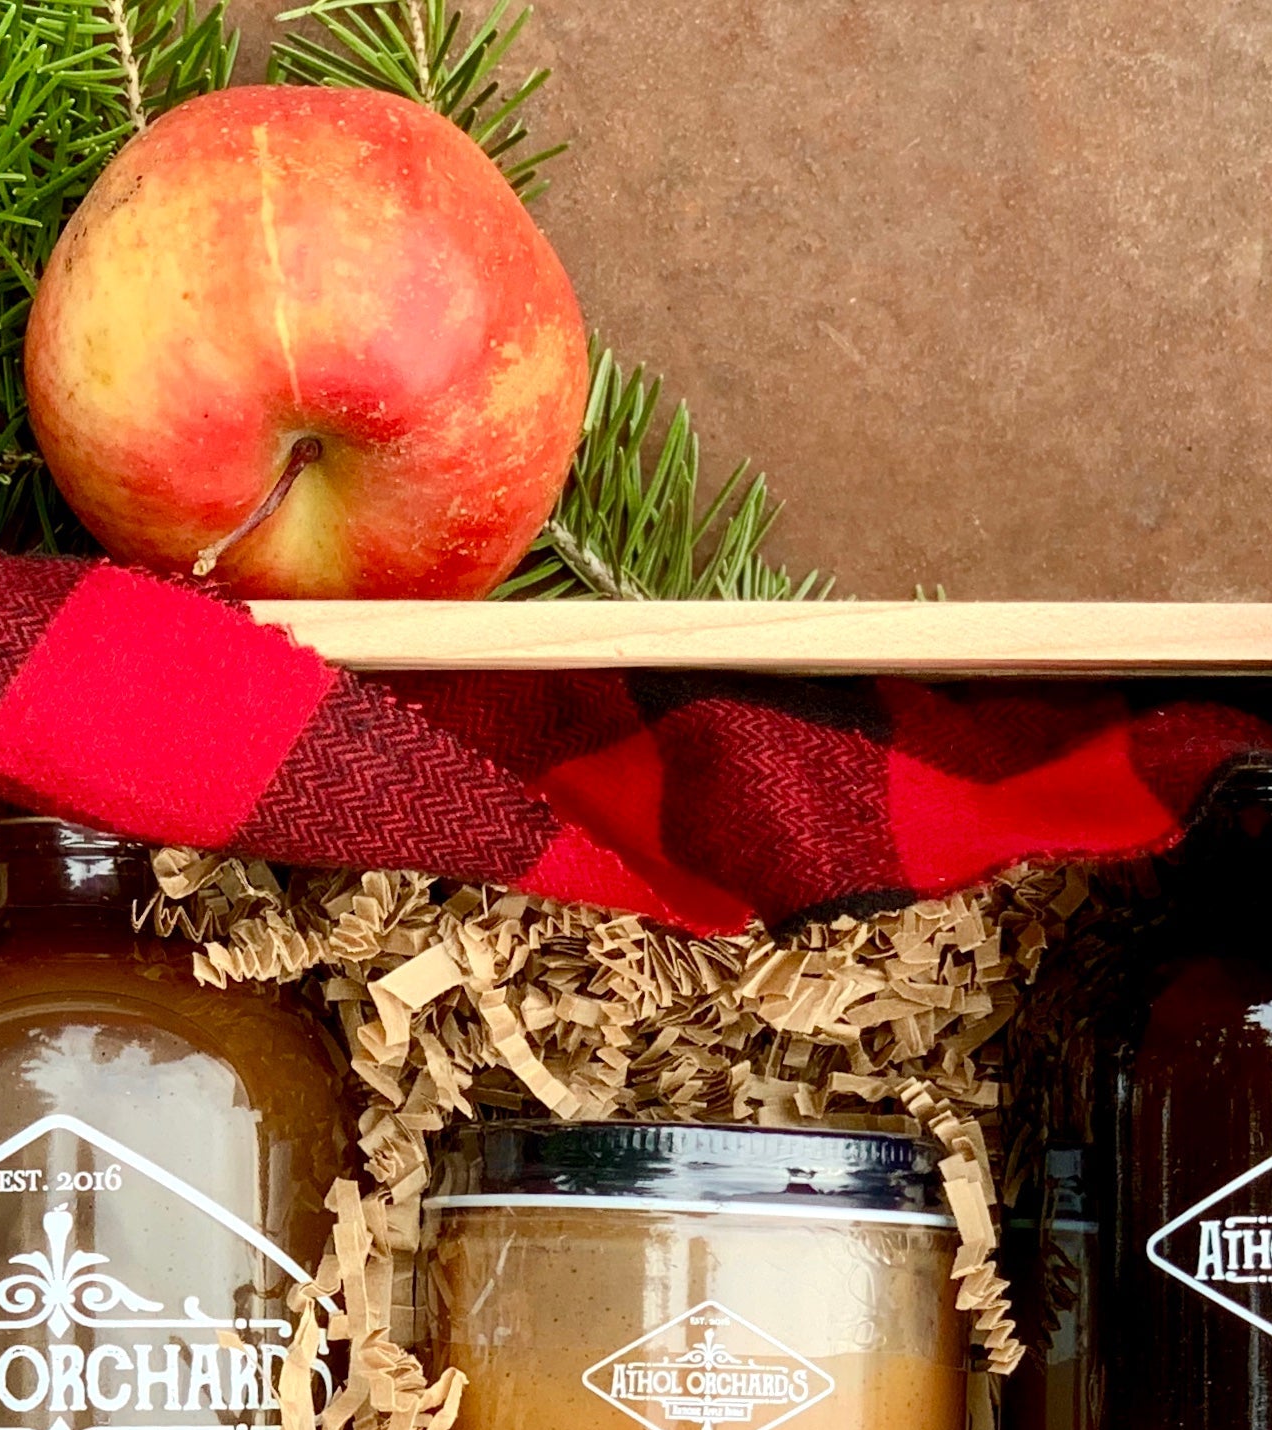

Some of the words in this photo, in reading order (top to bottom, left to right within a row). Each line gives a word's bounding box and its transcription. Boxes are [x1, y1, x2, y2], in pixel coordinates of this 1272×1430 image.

[57, 1164, 122, 1192] 2016
[611, 1364, 682, 1399] ATHOL
[686, 1369, 809, 1403] ORCHARDS
